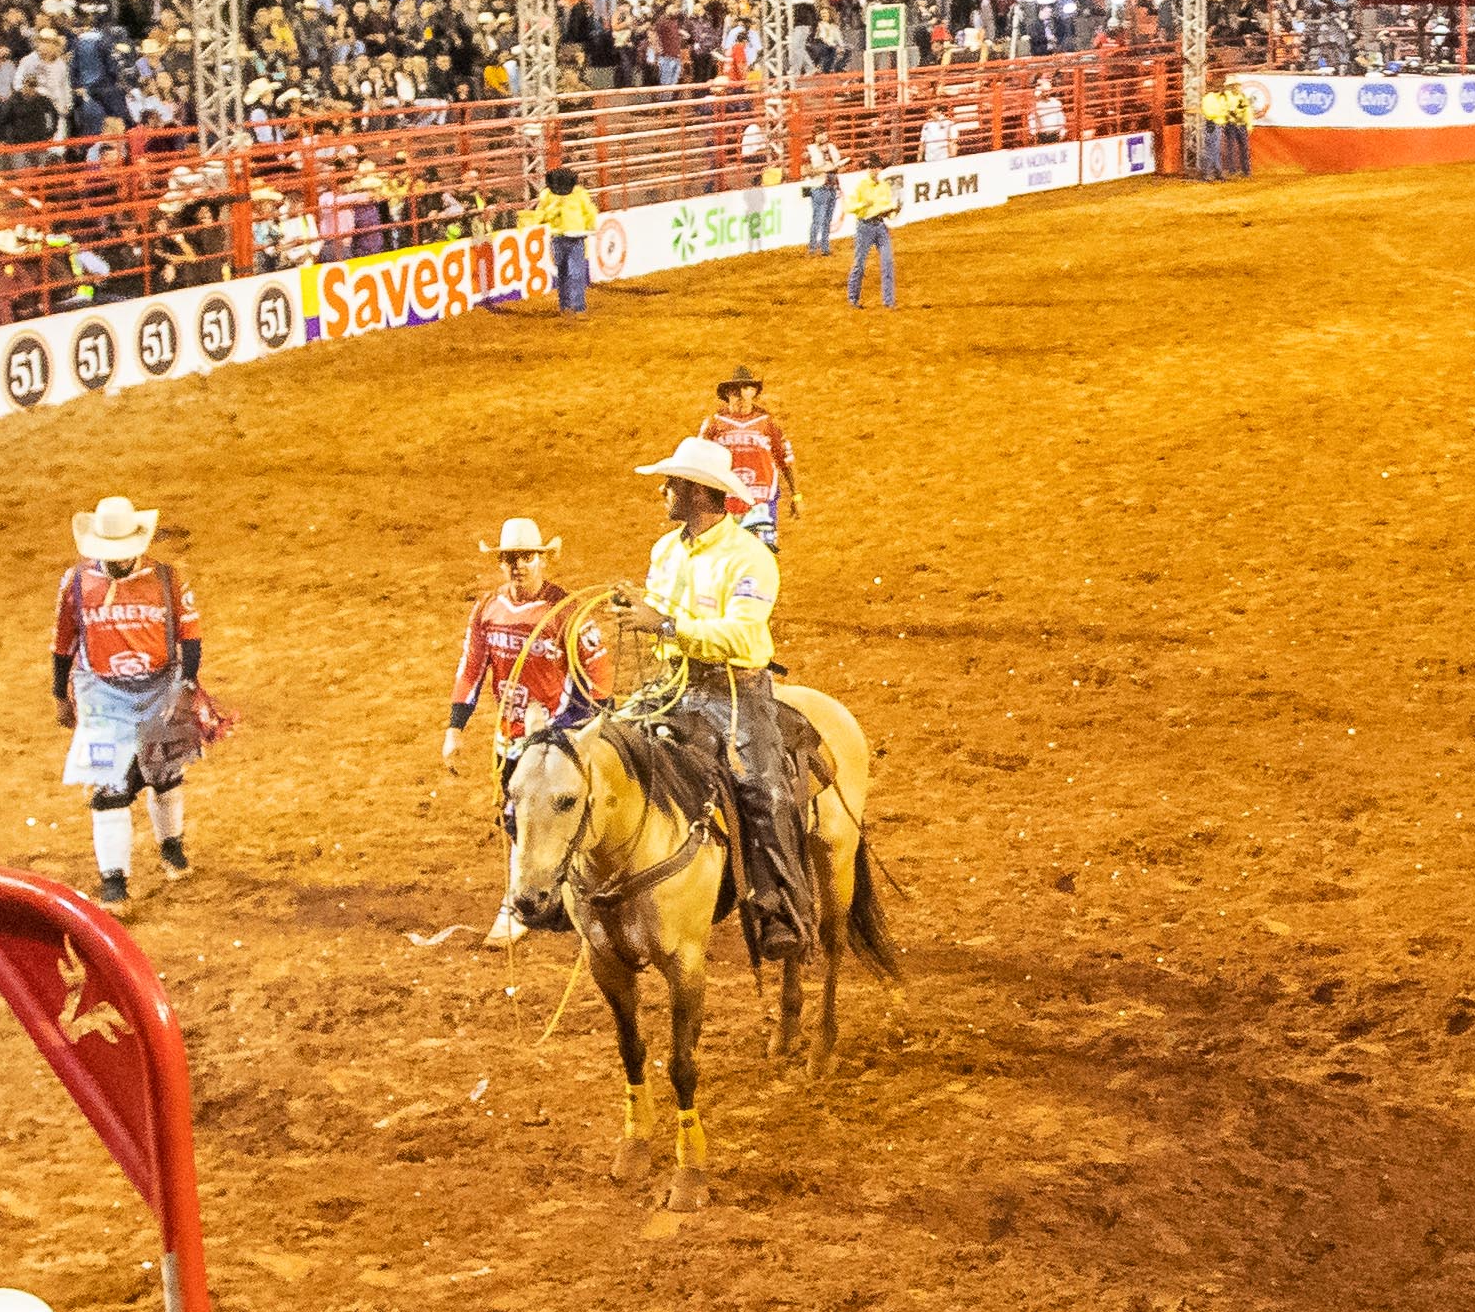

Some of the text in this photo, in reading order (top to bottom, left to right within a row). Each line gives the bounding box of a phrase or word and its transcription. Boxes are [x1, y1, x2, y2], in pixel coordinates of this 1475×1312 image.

[705, 201, 783, 249] Sicredi
[914, 173, 979, 203] RAM
[320, 222, 552, 339] Savegnag
[9, 347, 46, 398] 51
[77, 334, 114, 385] 51
[141, 316, 175, 366] 51
[202, 301, 235, 352] 51
[259, 292, 291, 340] 51
